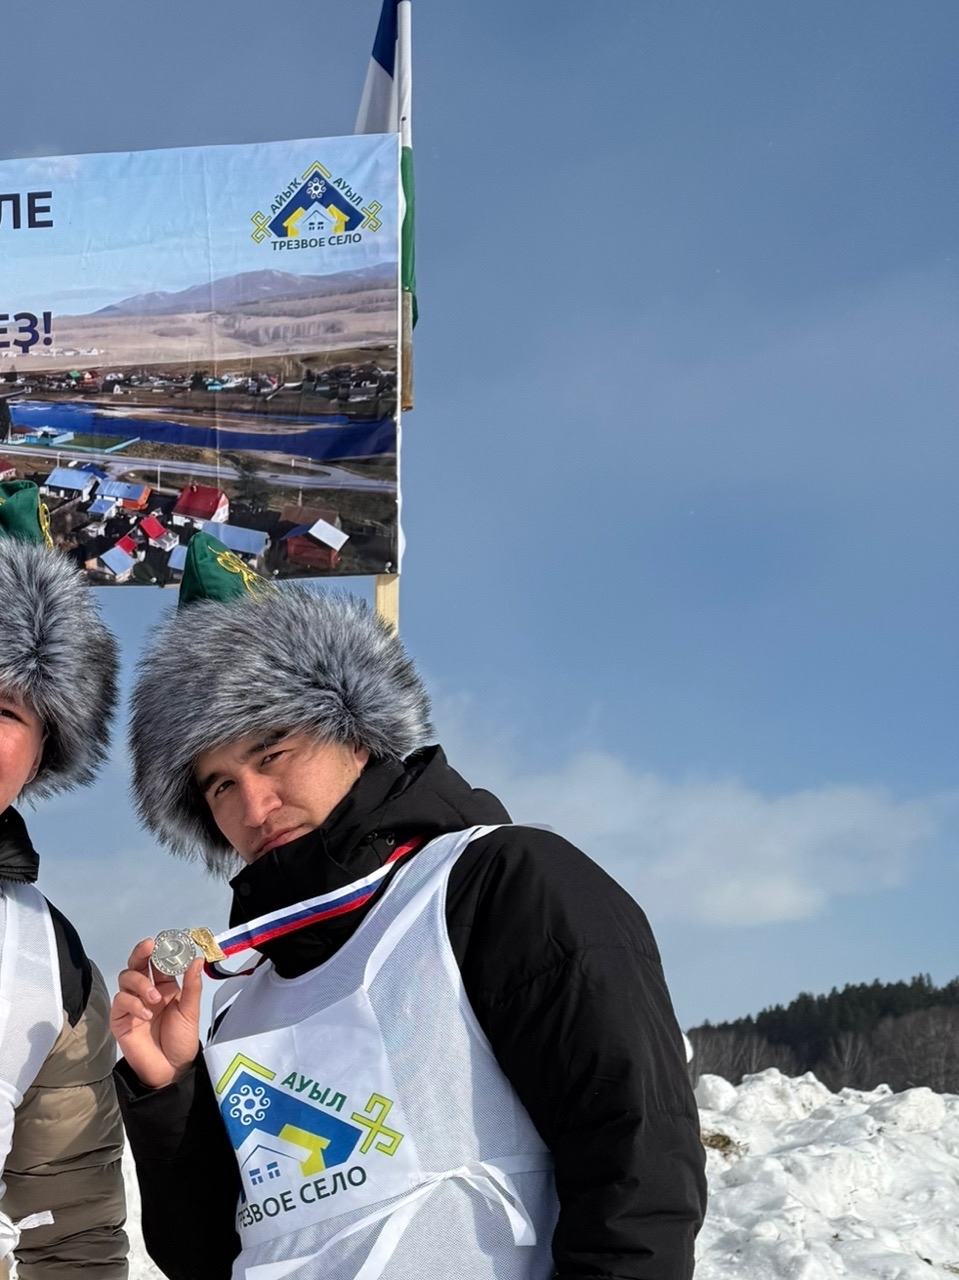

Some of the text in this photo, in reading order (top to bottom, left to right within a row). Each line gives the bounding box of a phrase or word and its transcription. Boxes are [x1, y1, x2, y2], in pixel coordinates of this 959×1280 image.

[333, 177, 363, 206] АУЫЛ
[271, 233, 362, 251] ТРЕЗВОЕ СЕЛО
[281, 1071, 347, 1112] АУЫЛ
[299, 1166, 367, 1203] СЕЛО
